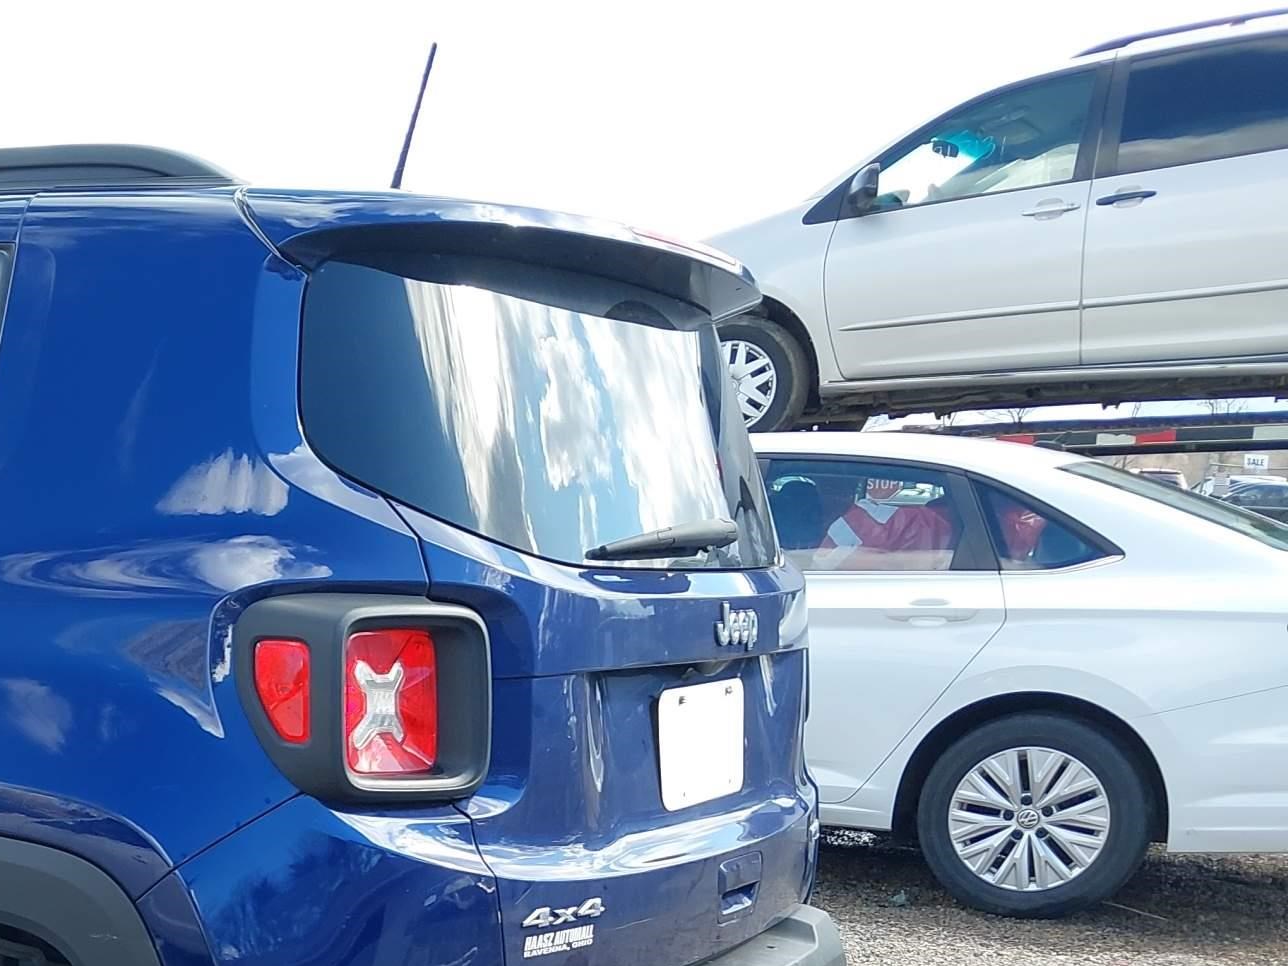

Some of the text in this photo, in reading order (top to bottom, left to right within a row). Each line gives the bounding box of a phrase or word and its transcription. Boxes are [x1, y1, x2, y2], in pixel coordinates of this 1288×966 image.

[1246, 457, 1265, 466] SALE
[866, 477, 899, 490] STOP
[715, 601, 759, 651] Jeep
[521, 896, 605, 928] 4x4
